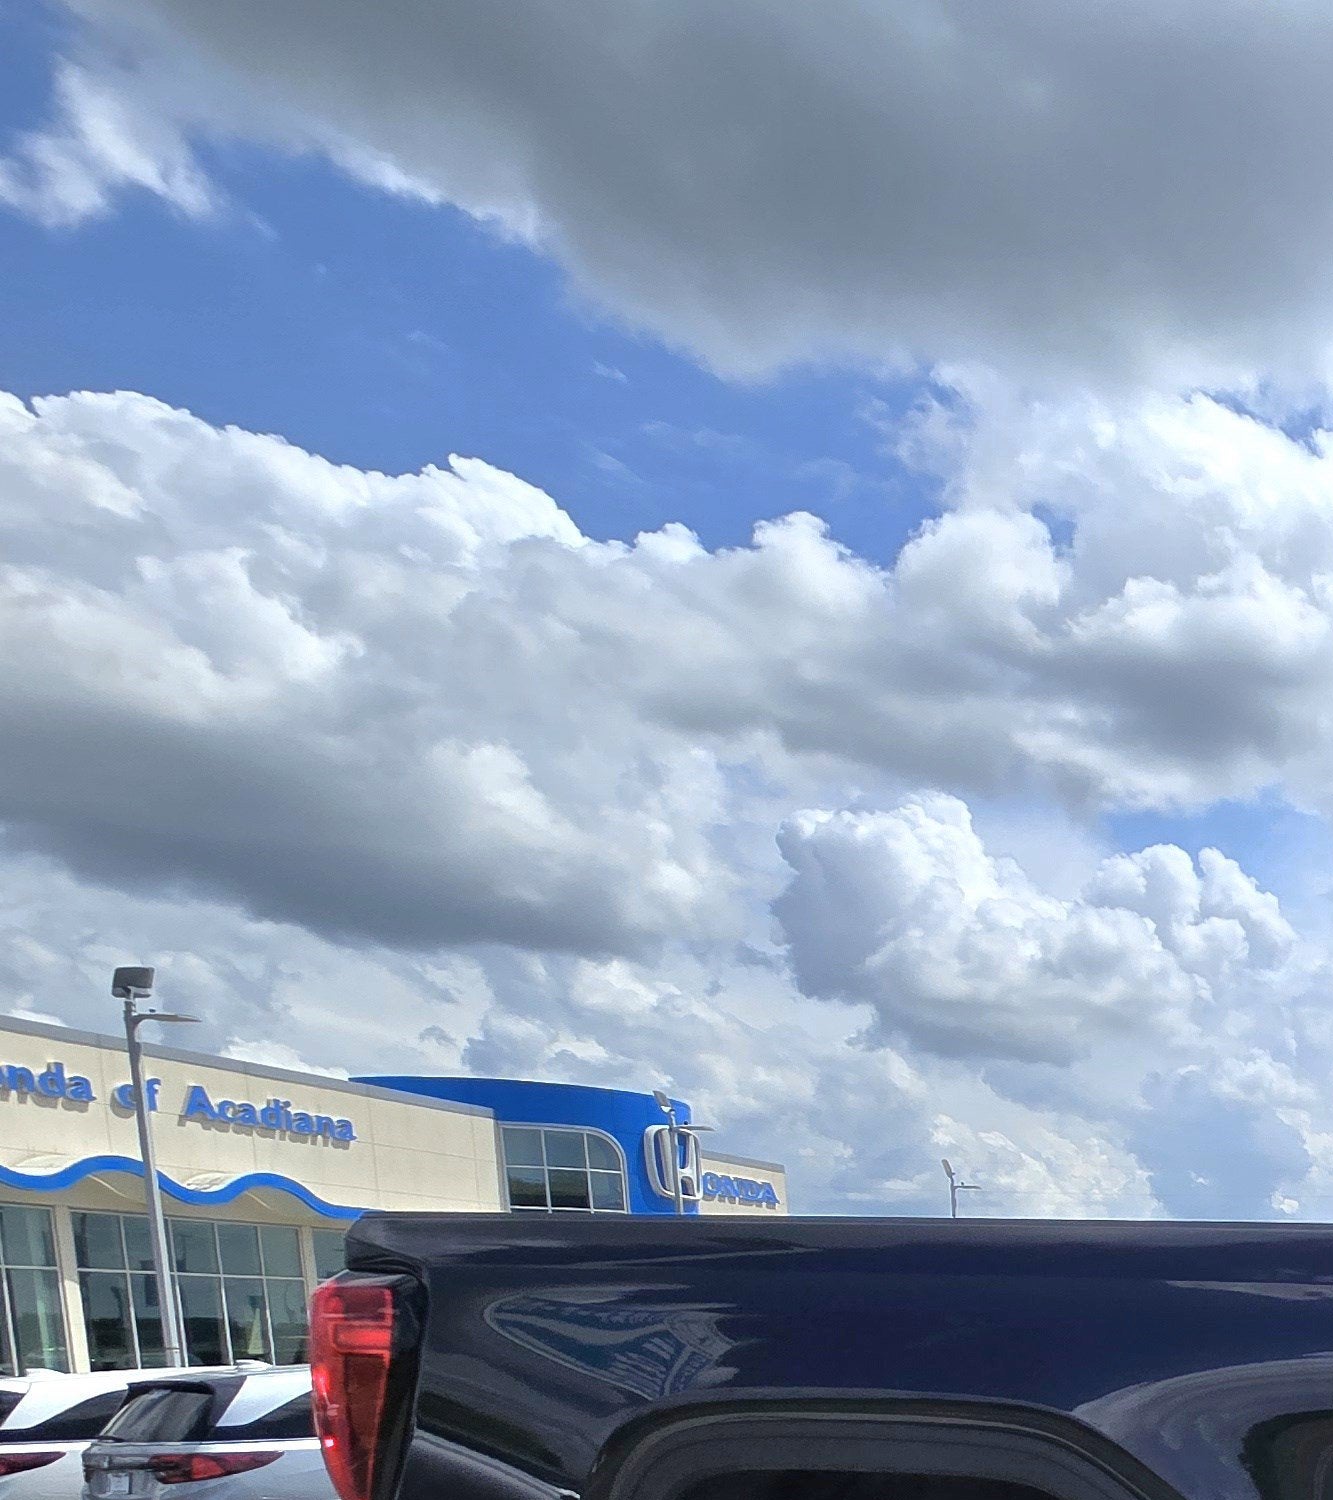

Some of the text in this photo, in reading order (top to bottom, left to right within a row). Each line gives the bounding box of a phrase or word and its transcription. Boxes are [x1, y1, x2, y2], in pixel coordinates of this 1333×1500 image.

[0, 1063, 358, 1142] nda of Acadiana
[702, 1172, 780, 1204] ONDA
